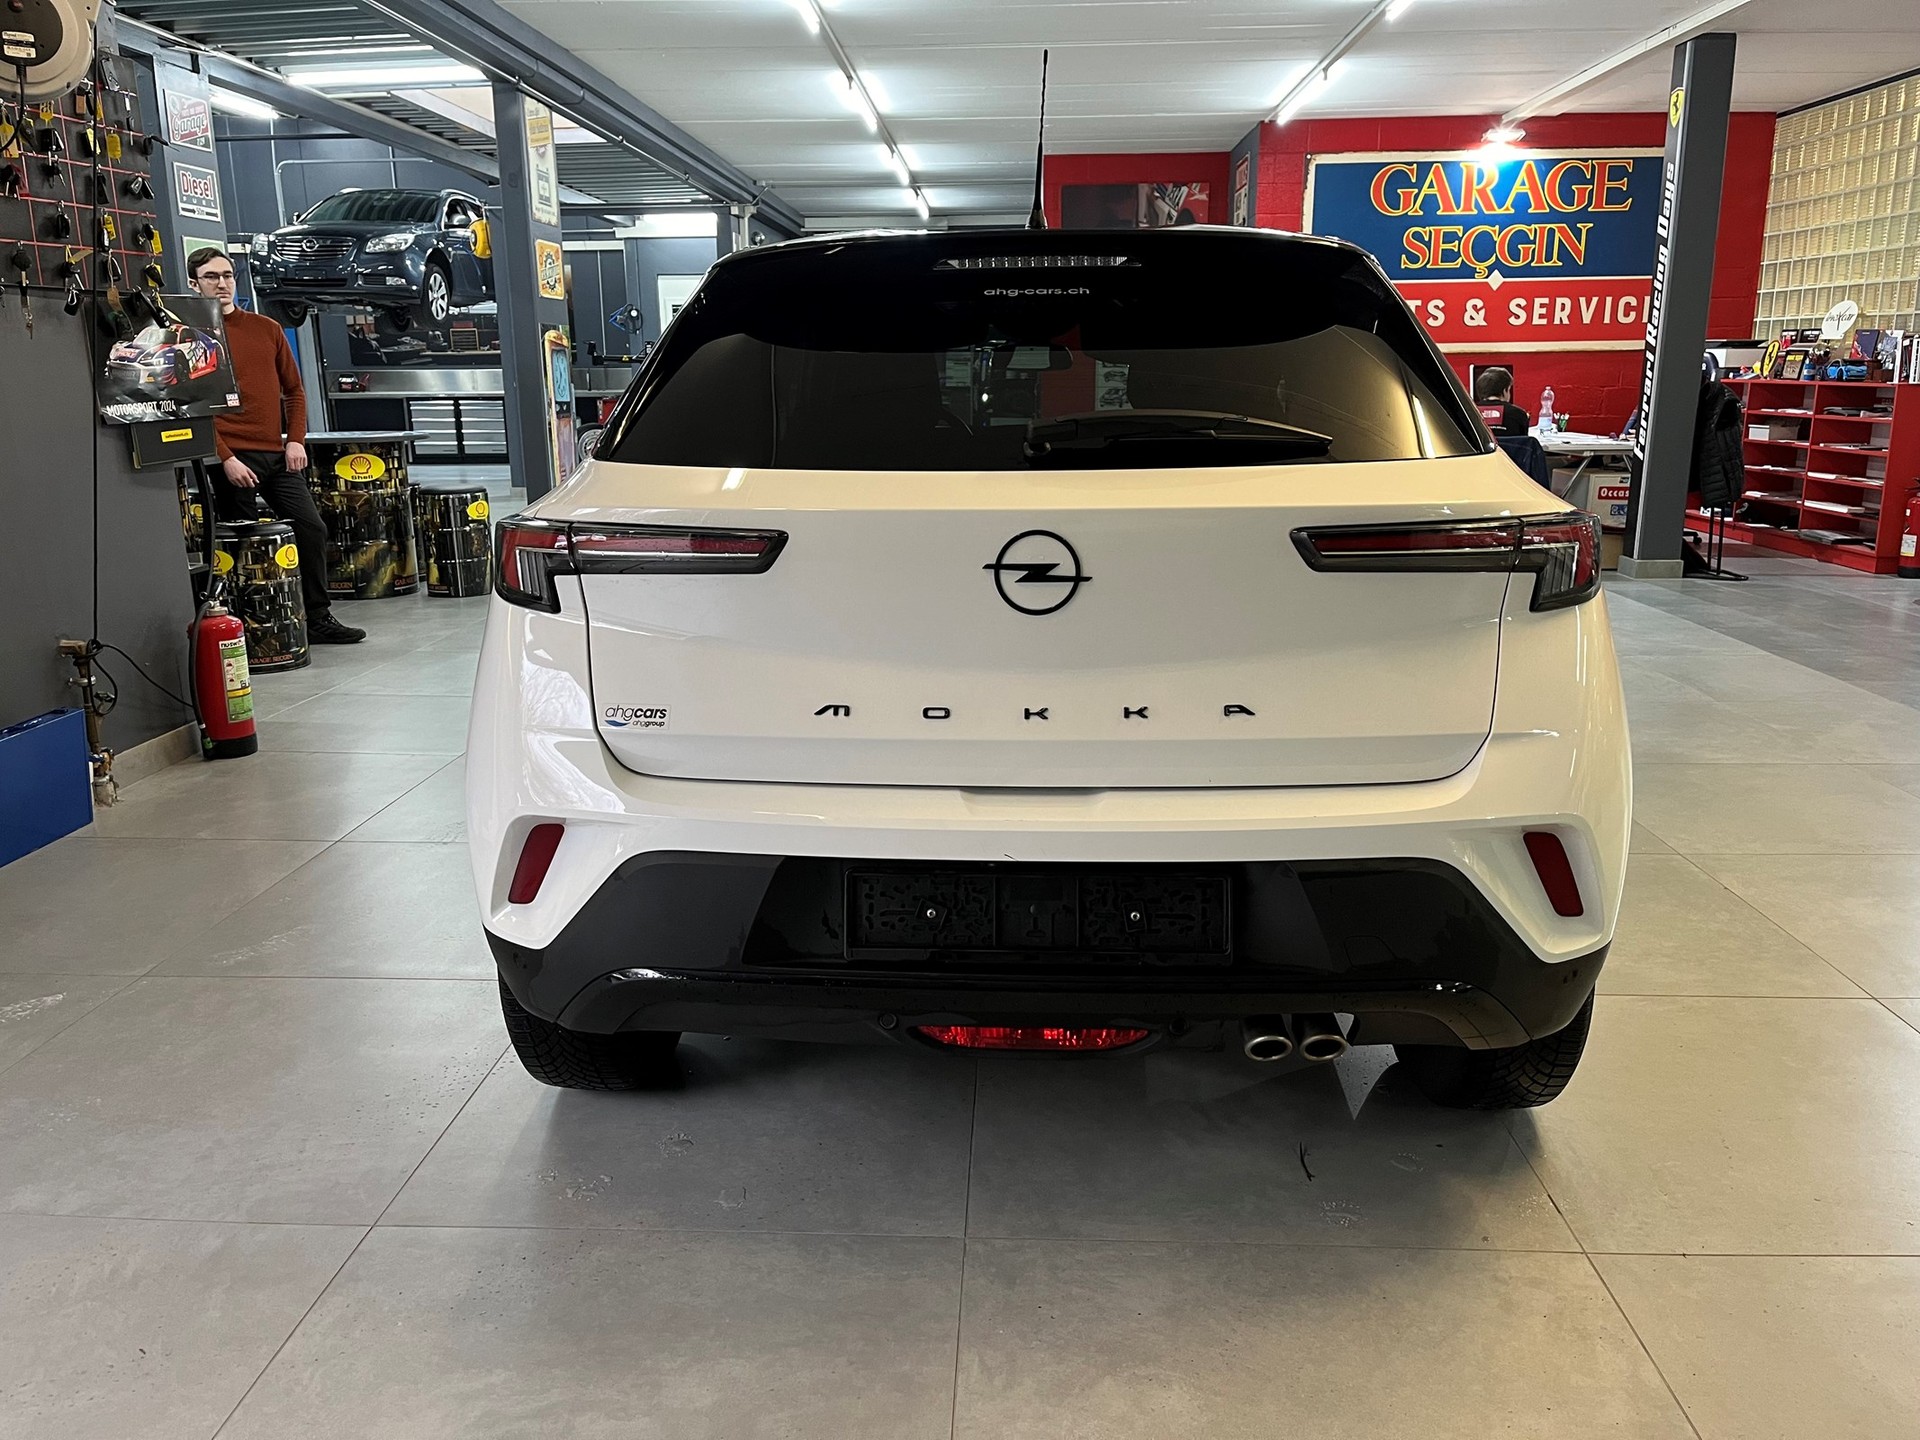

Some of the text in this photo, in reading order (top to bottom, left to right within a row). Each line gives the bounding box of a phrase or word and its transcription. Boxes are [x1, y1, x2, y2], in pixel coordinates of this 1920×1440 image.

[173, 112, 206, 141] Garage
[180, 171, 214, 200] Diesel
[1370, 160, 1633, 217] GARAGE
[183, 196, 215, 207] FUEL
[1401, 223, 1594, 279] SEÇGIN
[983, 287, 1090, 297] ahg-cars.ch
[1463, 298, 1488, 327] &
[1634, 161, 1675, 460] Ferrari Racing Days
[106, 399, 177, 416] MOTORSPORT 2024
[605, 705, 668, 721] ahgcars
[813, 703, 1256, 721] MOKKA
